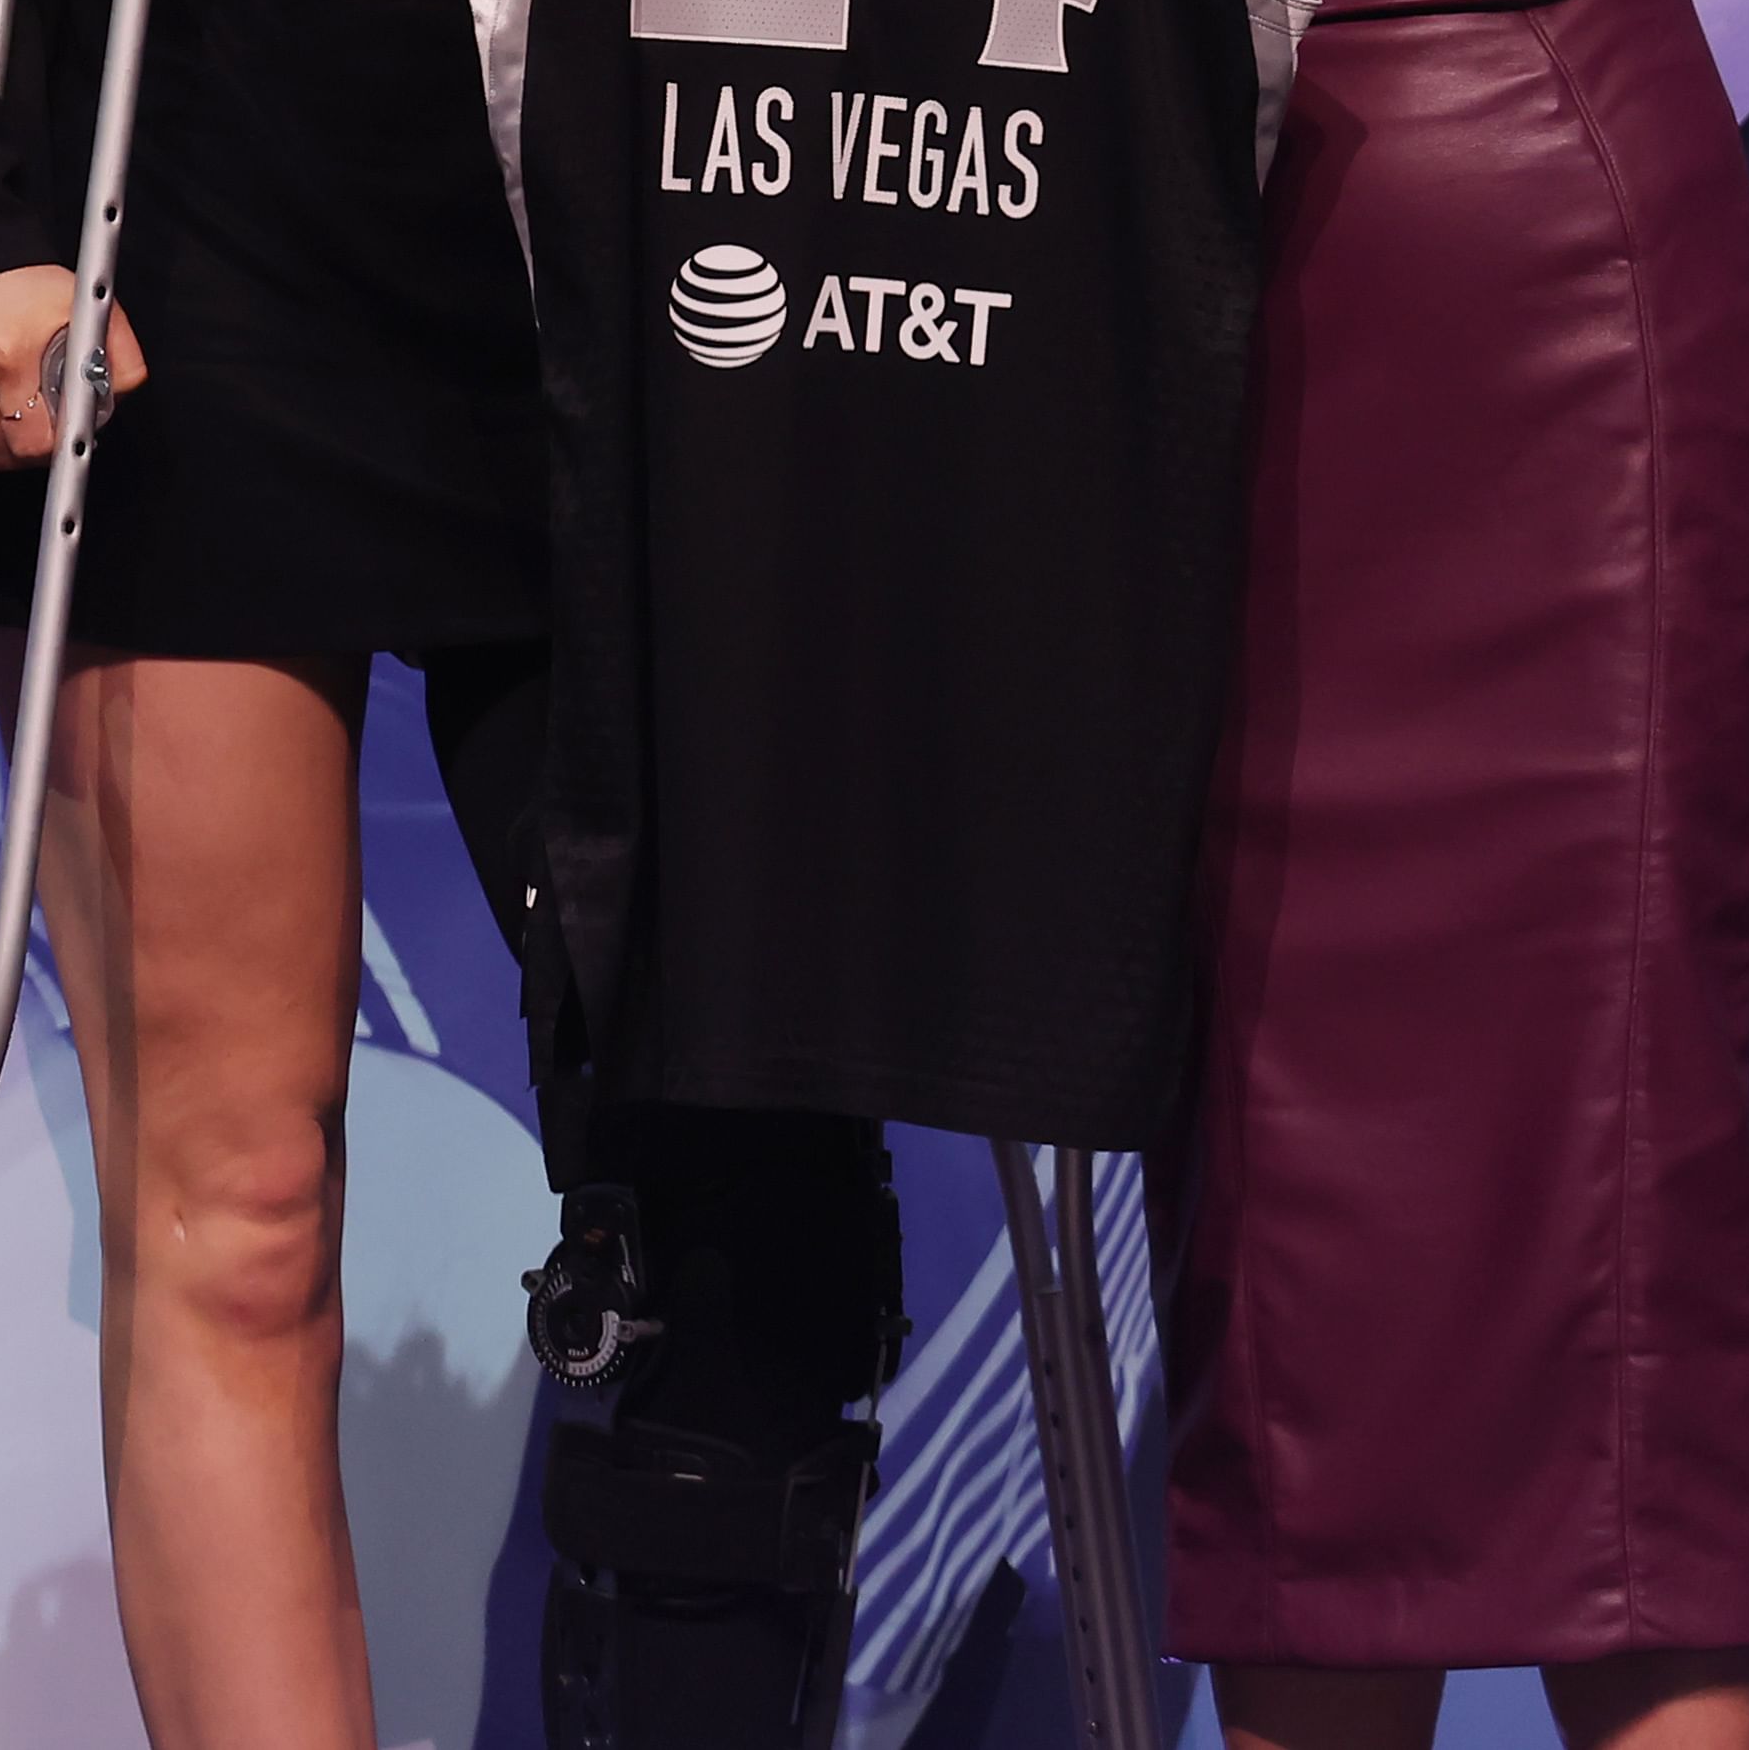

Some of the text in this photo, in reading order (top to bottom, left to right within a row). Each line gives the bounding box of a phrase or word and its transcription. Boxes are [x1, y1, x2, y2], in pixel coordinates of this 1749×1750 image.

[661, 81, 1044, 220] LAS VEGAS
[802, 274, 1012, 367] AT&T
